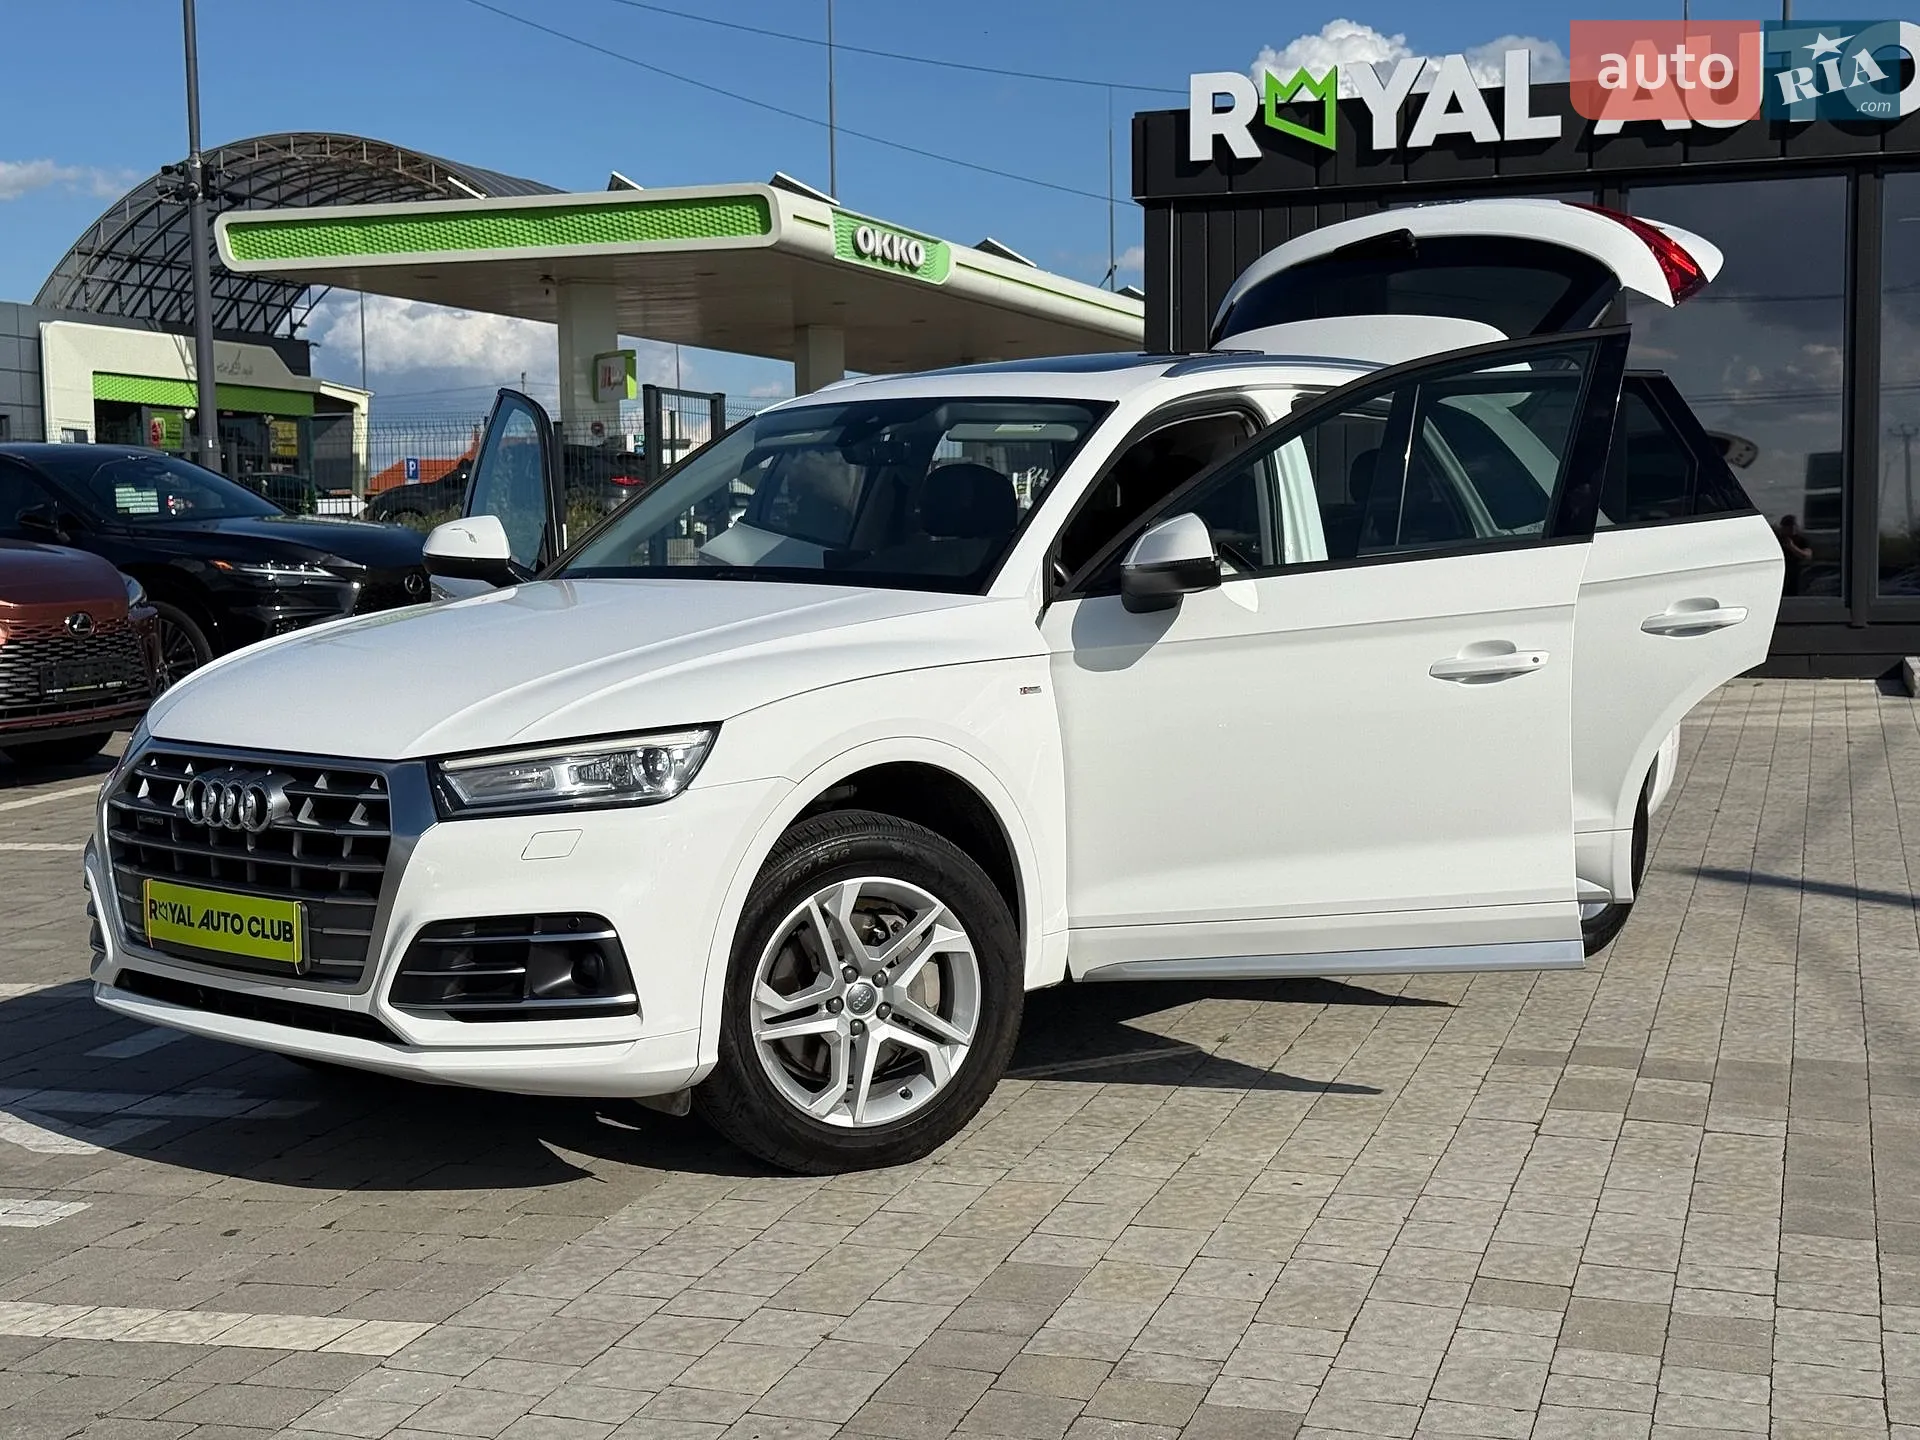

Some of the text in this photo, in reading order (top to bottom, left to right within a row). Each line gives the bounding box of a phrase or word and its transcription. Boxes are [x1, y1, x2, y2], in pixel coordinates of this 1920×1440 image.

[857, 226, 926, 267] OKKO
[409, 461, 416, 477] P
[198, 909, 244, 935] AUTO
[247, 916, 294, 943] CLUB
